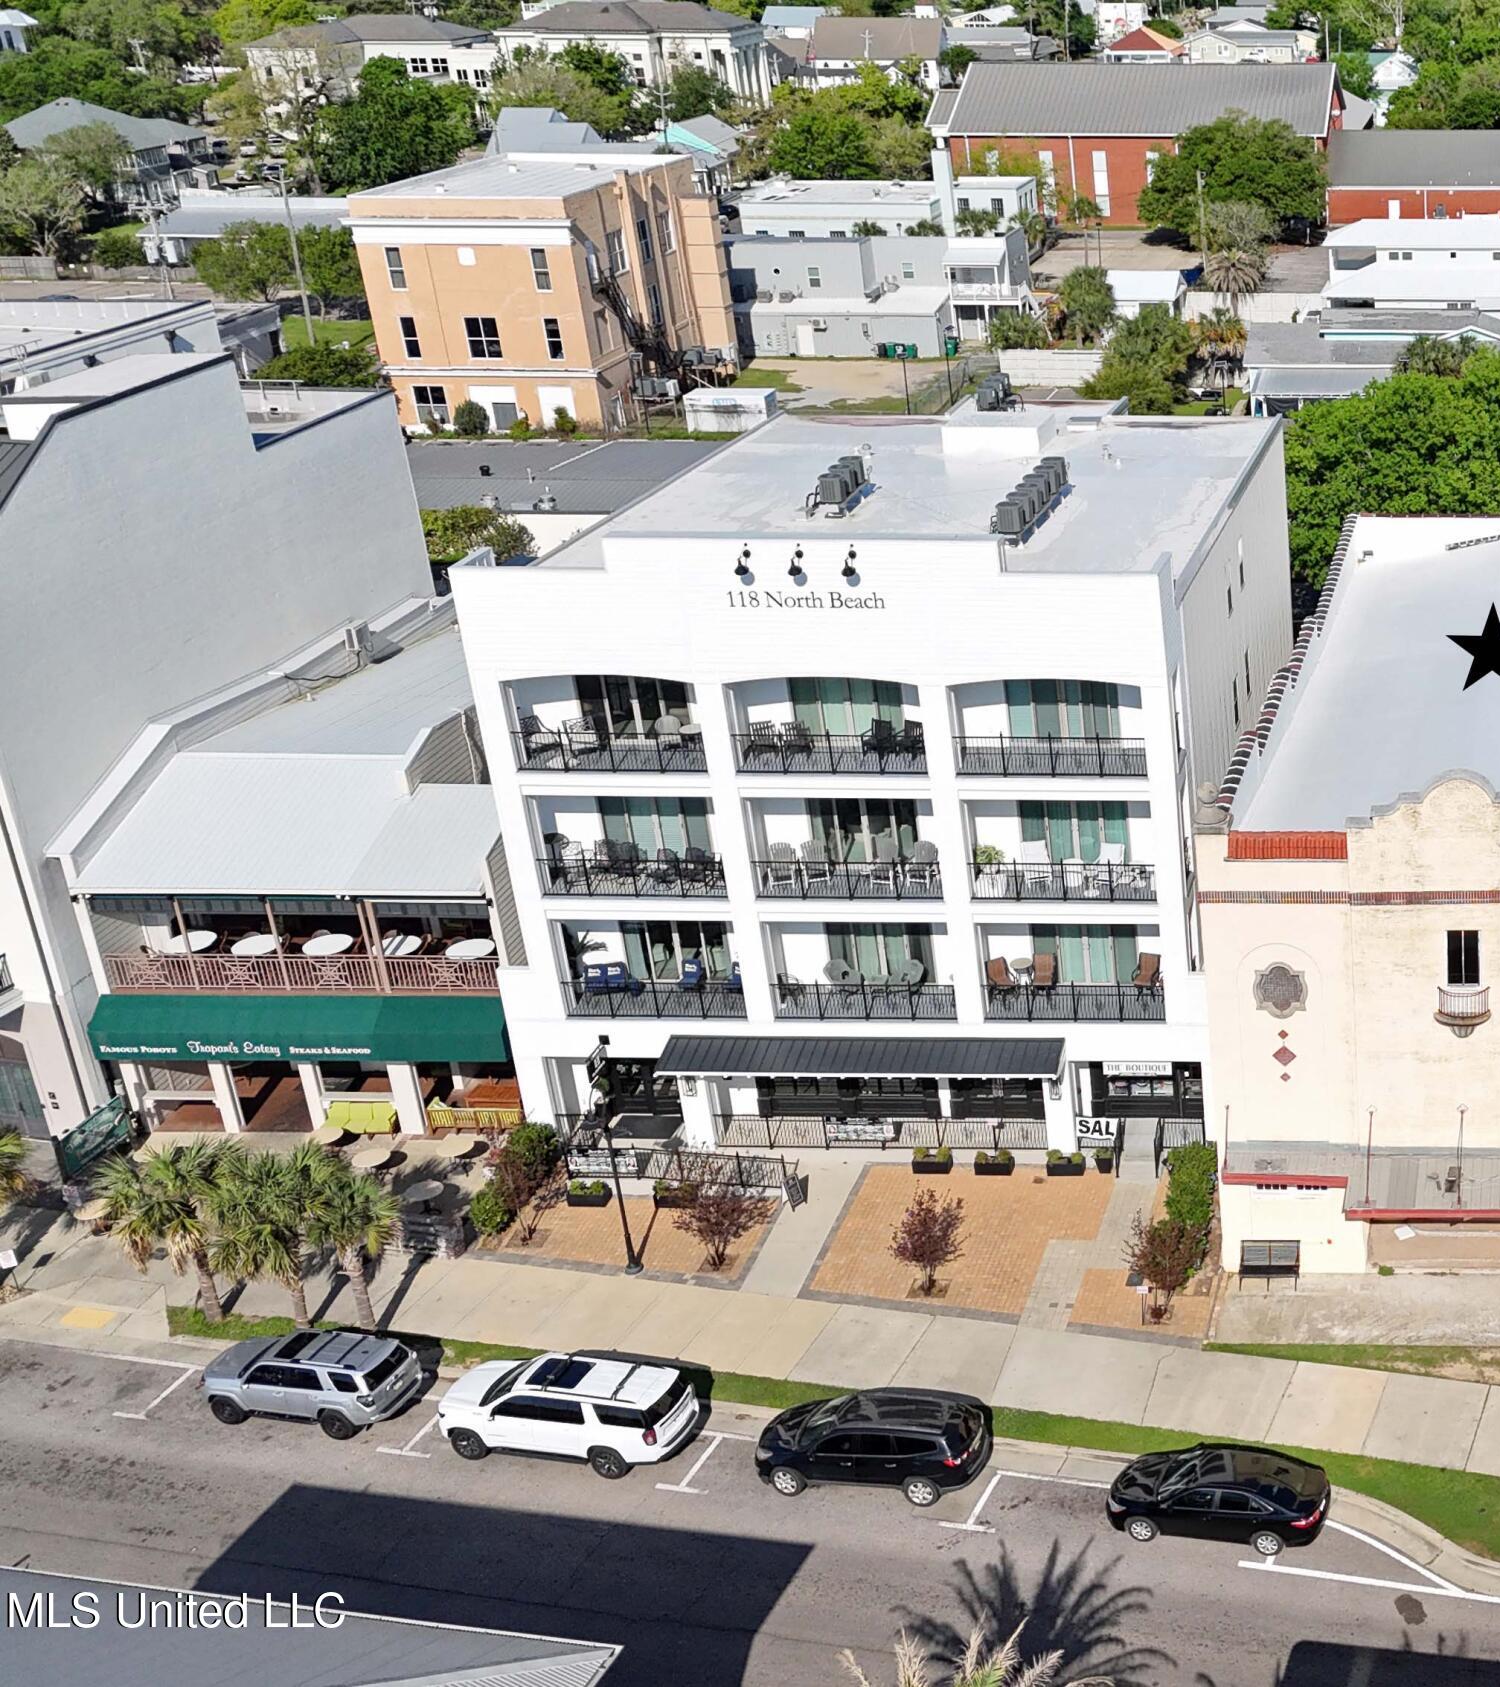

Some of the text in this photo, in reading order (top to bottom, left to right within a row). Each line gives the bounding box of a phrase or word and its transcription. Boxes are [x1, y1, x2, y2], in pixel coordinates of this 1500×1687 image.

[726, 590, 886, 609] 118 North Beach
[243, 1041, 281, 1057] Eatery
[1106, 1063, 1168, 1072] THE BOUTIQUE
[1078, 1119, 1115, 1138] SAL
